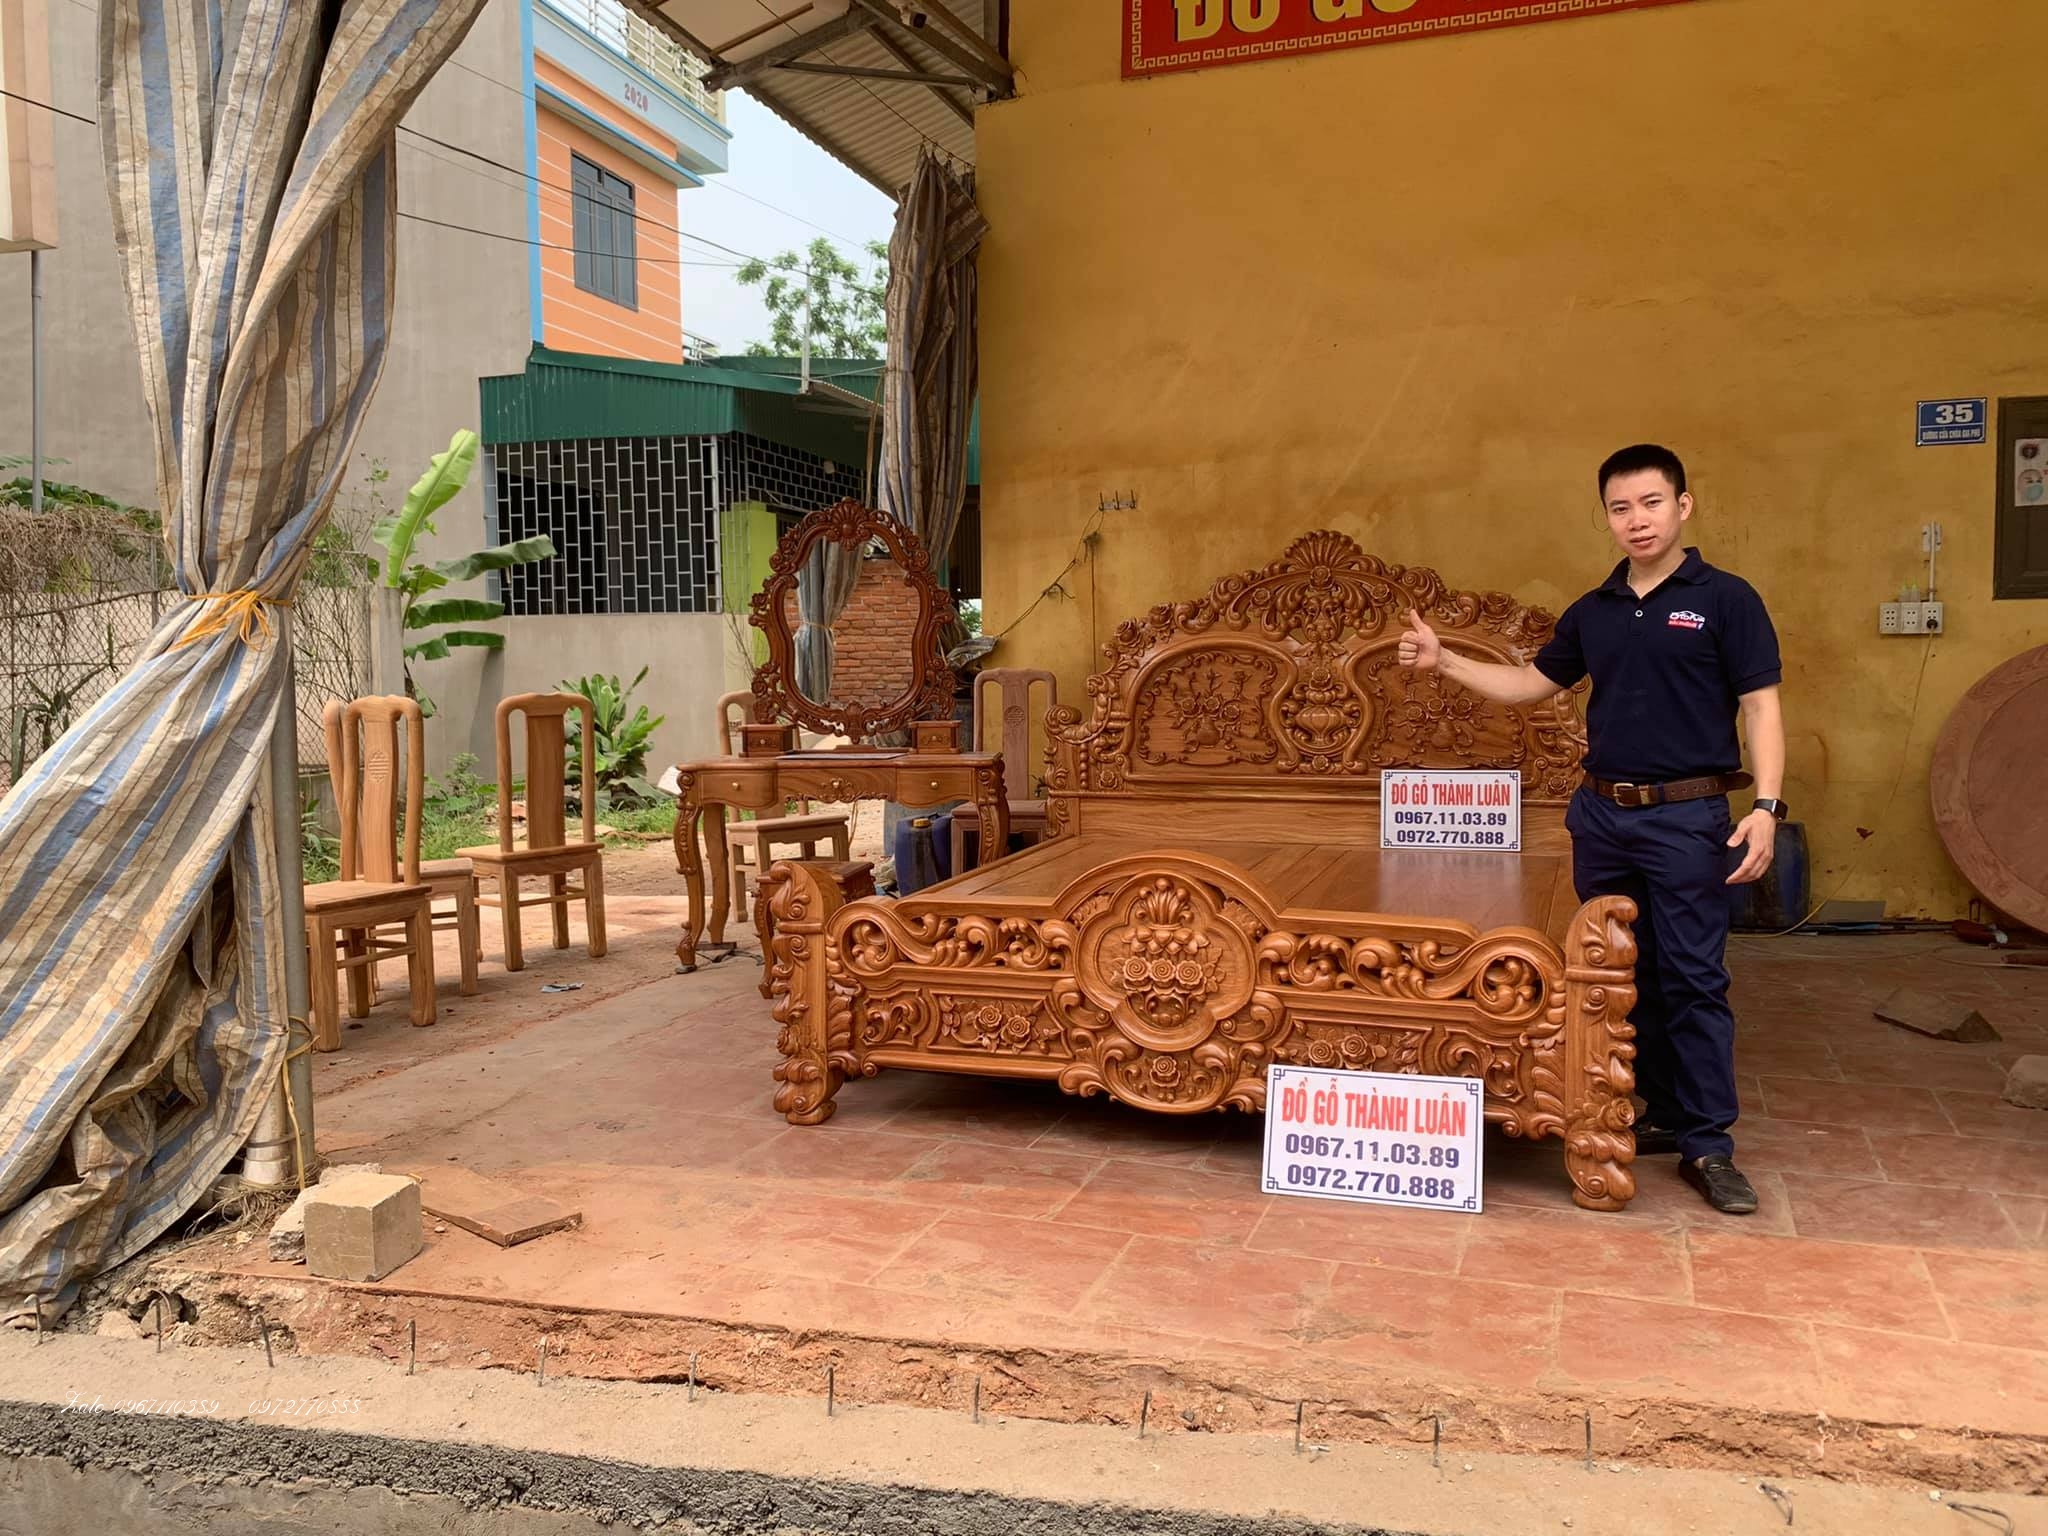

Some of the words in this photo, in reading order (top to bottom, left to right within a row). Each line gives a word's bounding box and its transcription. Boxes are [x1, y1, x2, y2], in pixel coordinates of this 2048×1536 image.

[624, 83, 649, 112] 2020
[1935, 403, 1974, 425] 35
[1391, 776, 1408, 805] ĐỒ
[1412, 775, 1428, 805] GỖ
[1432, 779, 1473, 806] THÀNH
[1477, 779, 1510, 806] LUÂN
[1394, 811, 1507, 826] 0967.11.03.89
[1397, 829, 1505, 845] 0972.770.888
[1281, 1076, 1308, 1123] ĐỒ
[1313, 1077, 1339, 1126] GỖ
[1345, 1087, 1408, 1132] THÀNH
[1414, 1092, 1466, 1137] LUÂN
[1285, 1133, 1460, 1169] 0967.11.03.89
[1287, 1163, 1455, 1200] 0972.770.888
